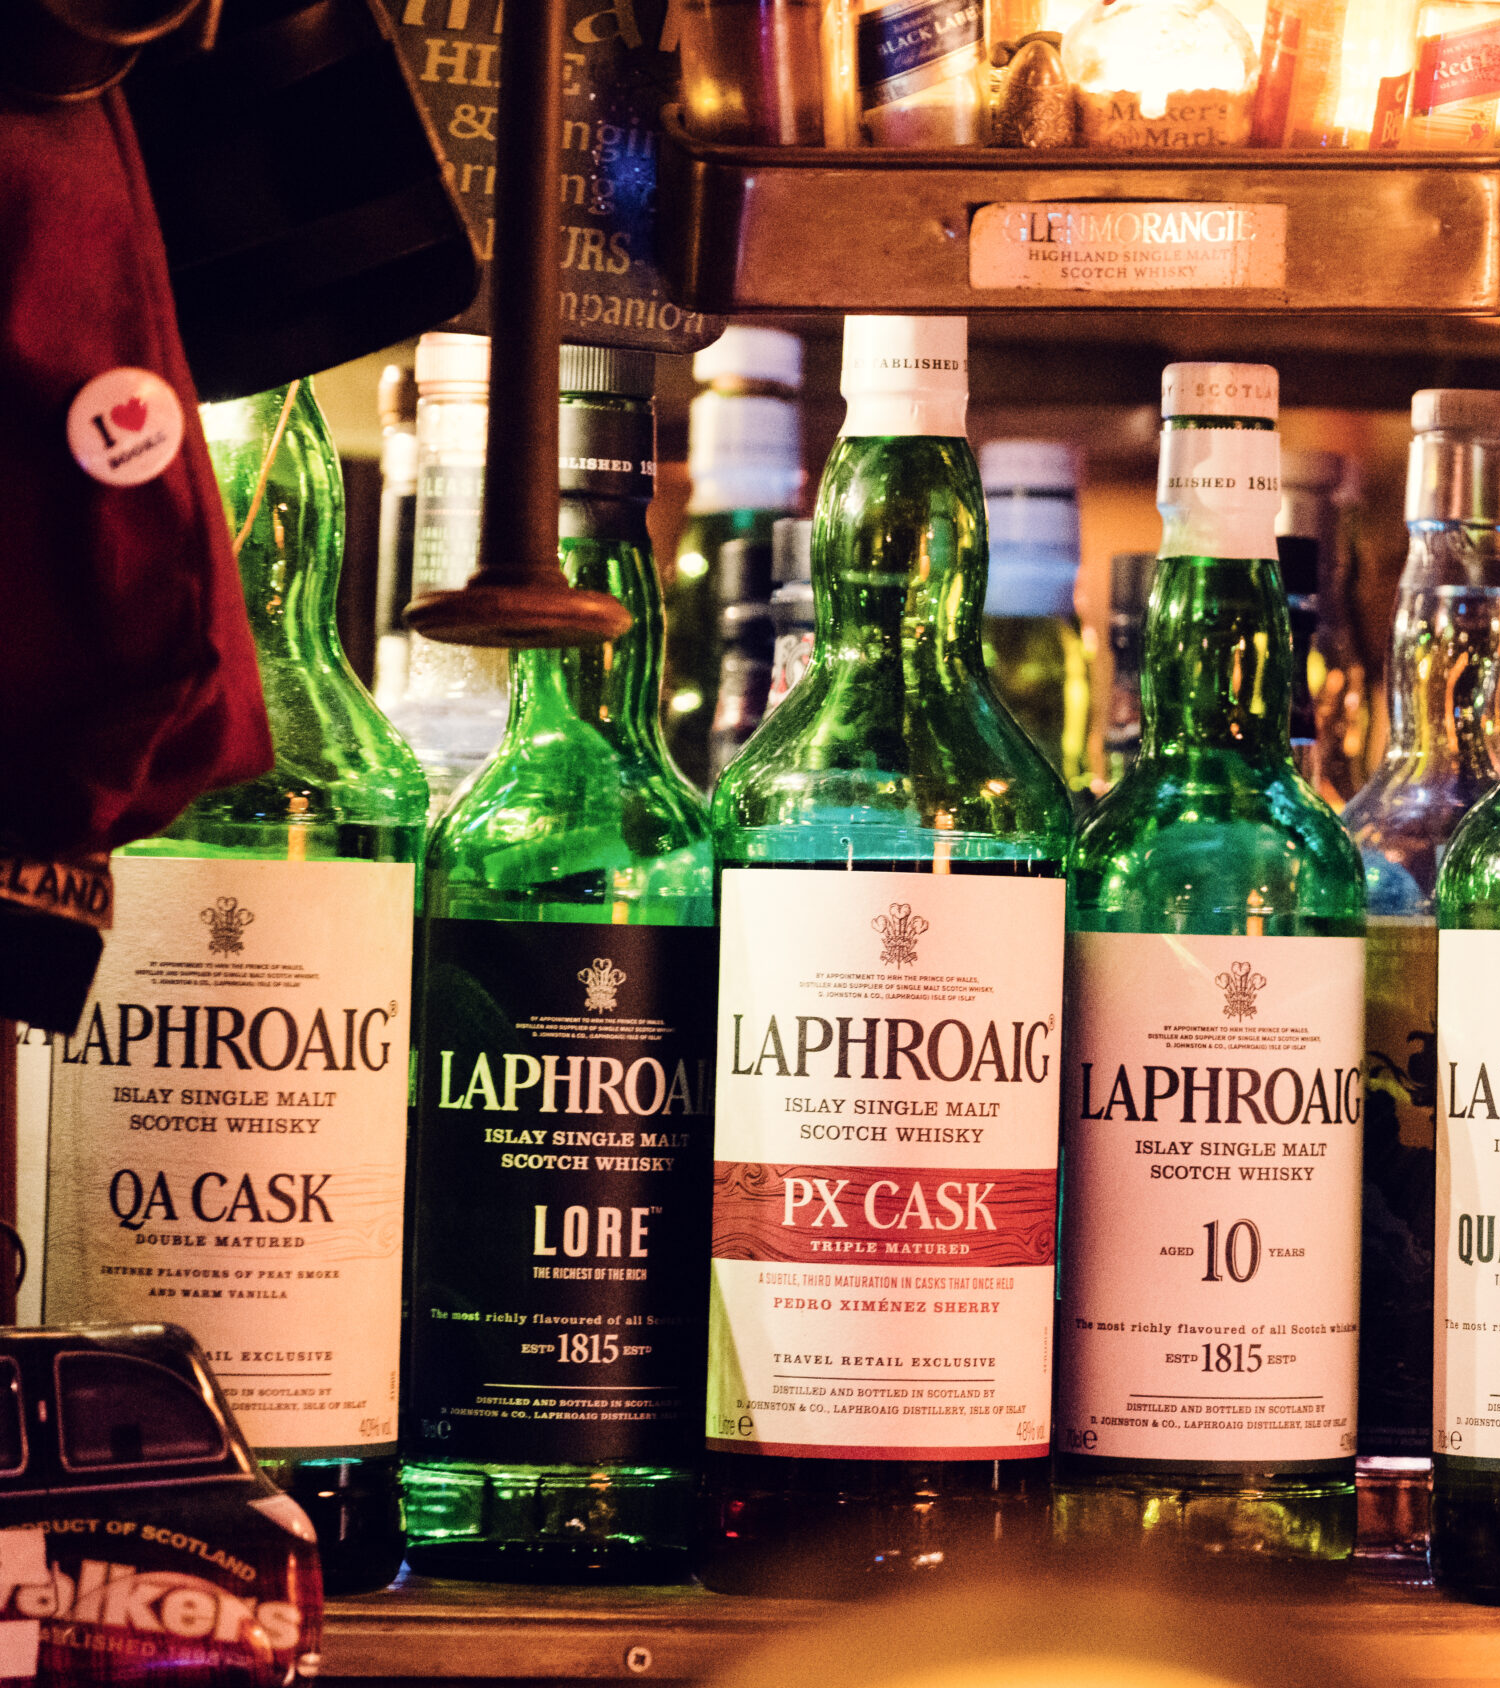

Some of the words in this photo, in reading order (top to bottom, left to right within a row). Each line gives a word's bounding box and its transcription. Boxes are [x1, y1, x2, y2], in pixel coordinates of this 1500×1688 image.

[1110, 101, 1228, 122] Mker's
[1004, 210, 1257, 244] GLENMORANGIE
[1028, 249, 1118, 262] HIGHLAND
[1122, 249, 1182, 262] SINGLE
[1186, 248, 1229, 261] MALT
[1061, 267, 1127, 279] SCOTCH
[1134, 265, 1198, 279] WHISKY
[0, 858, 110, 914] LAND
[731, 1013, 1050, 1085] LAPHROAIG
[114, 1087, 174, 1105] ISLAY
[181, 1089, 269, 1107] SINGLE
[276, 1091, 337, 1108] MALT
[1079, 1062, 1361, 1126] LAPHROAIG
[784, 1097, 846, 1114] ISLAY
[854, 1099, 938, 1117] SINGLE
[946, 1101, 1001, 1118] MALT
[130, 1115, 217, 1133] SCOTCH
[226, 1117, 322, 1134] WHISKY
[484, 1128, 548, 1144] ISLAY
[552, 1130, 634, 1147] SINGLE
[800, 1125, 887, 1142] SCOTCH
[895, 1127, 985, 1144] WHISKY
[501, 1154, 589, 1171] SCOTCH
[594, 1156, 675, 1172] WHISKY
[109, 1168, 179, 1231] QA
[191, 1171, 334, 1223] CASK
[781, 1177, 850, 1229] PX
[863, 1179, 998, 1232] CASK
[136, 1233, 206, 1247] DOUBLE
[214, 1235, 306, 1248] MATURED
[532, 1204, 650, 1259] LORE
[809, 1240, 878, 1254] TRIPLE
[885, 1241, 971, 1255] MATURED
[1160, 1246, 1194, 1258] AGED
[1201, 1219, 1262, 1284] 10
[1268, 1247, 1305, 1258] YEARS
[157, 1267, 231, 1279] FLAVOURS
[234, 1269, 252, 1279] OF
[257, 1270, 292, 1280] PEAT
[297, 1270, 341, 1280] SMOKE
[533, 1266, 551, 1279] THE
[552, 1266, 594, 1280] RICHEST
[594, 1267, 608, 1280] OF
[608, 1267, 625, 1280] THE
[625, 1267, 647, 1281] RICH
[758, 1272, 765, 1284] A
[765, 1272, 801, 1288] SUBTLE,
[802, 1273, 832, 1288] THIRD
[834, 1273, 899, 1289] MATURATION
[901, 1276, 912, 1289] IN
[915, 1276, 947, 1290] CASKS
[948, 1276, 971, 1290] THAT
[972, 1276, 994, 1290] ONCE
[996, 1276, 1015, 1291] HELD
[148, 1287, 176, 1298] AND
[182, 1288, 223, 1299] WARM
[228, 1289, 289, 1300] VANILLA
[773, 1297, 832, 1312] PEDRO
[839, 1297, 927, 1313] XIMÉNEZ
[933, 1301, 1001, 1314] SHERRY
[1444, 1318, 1460, 1331] The
[1462, 1321, 1487, 1332] most
[557, 1333, 619, 1364] 1815
[1201, 1342, 1263, 1374] 1815
[773, 1353, 833, 1366] TRAVEL
[841, 1354, 903, 1368] RETAIL
[911, 1356, 996, 1369] EXCLUSIVE
[106, 1520, 137, 1536] OF
[140, 1525, 258, 1583] SCOTLAND
